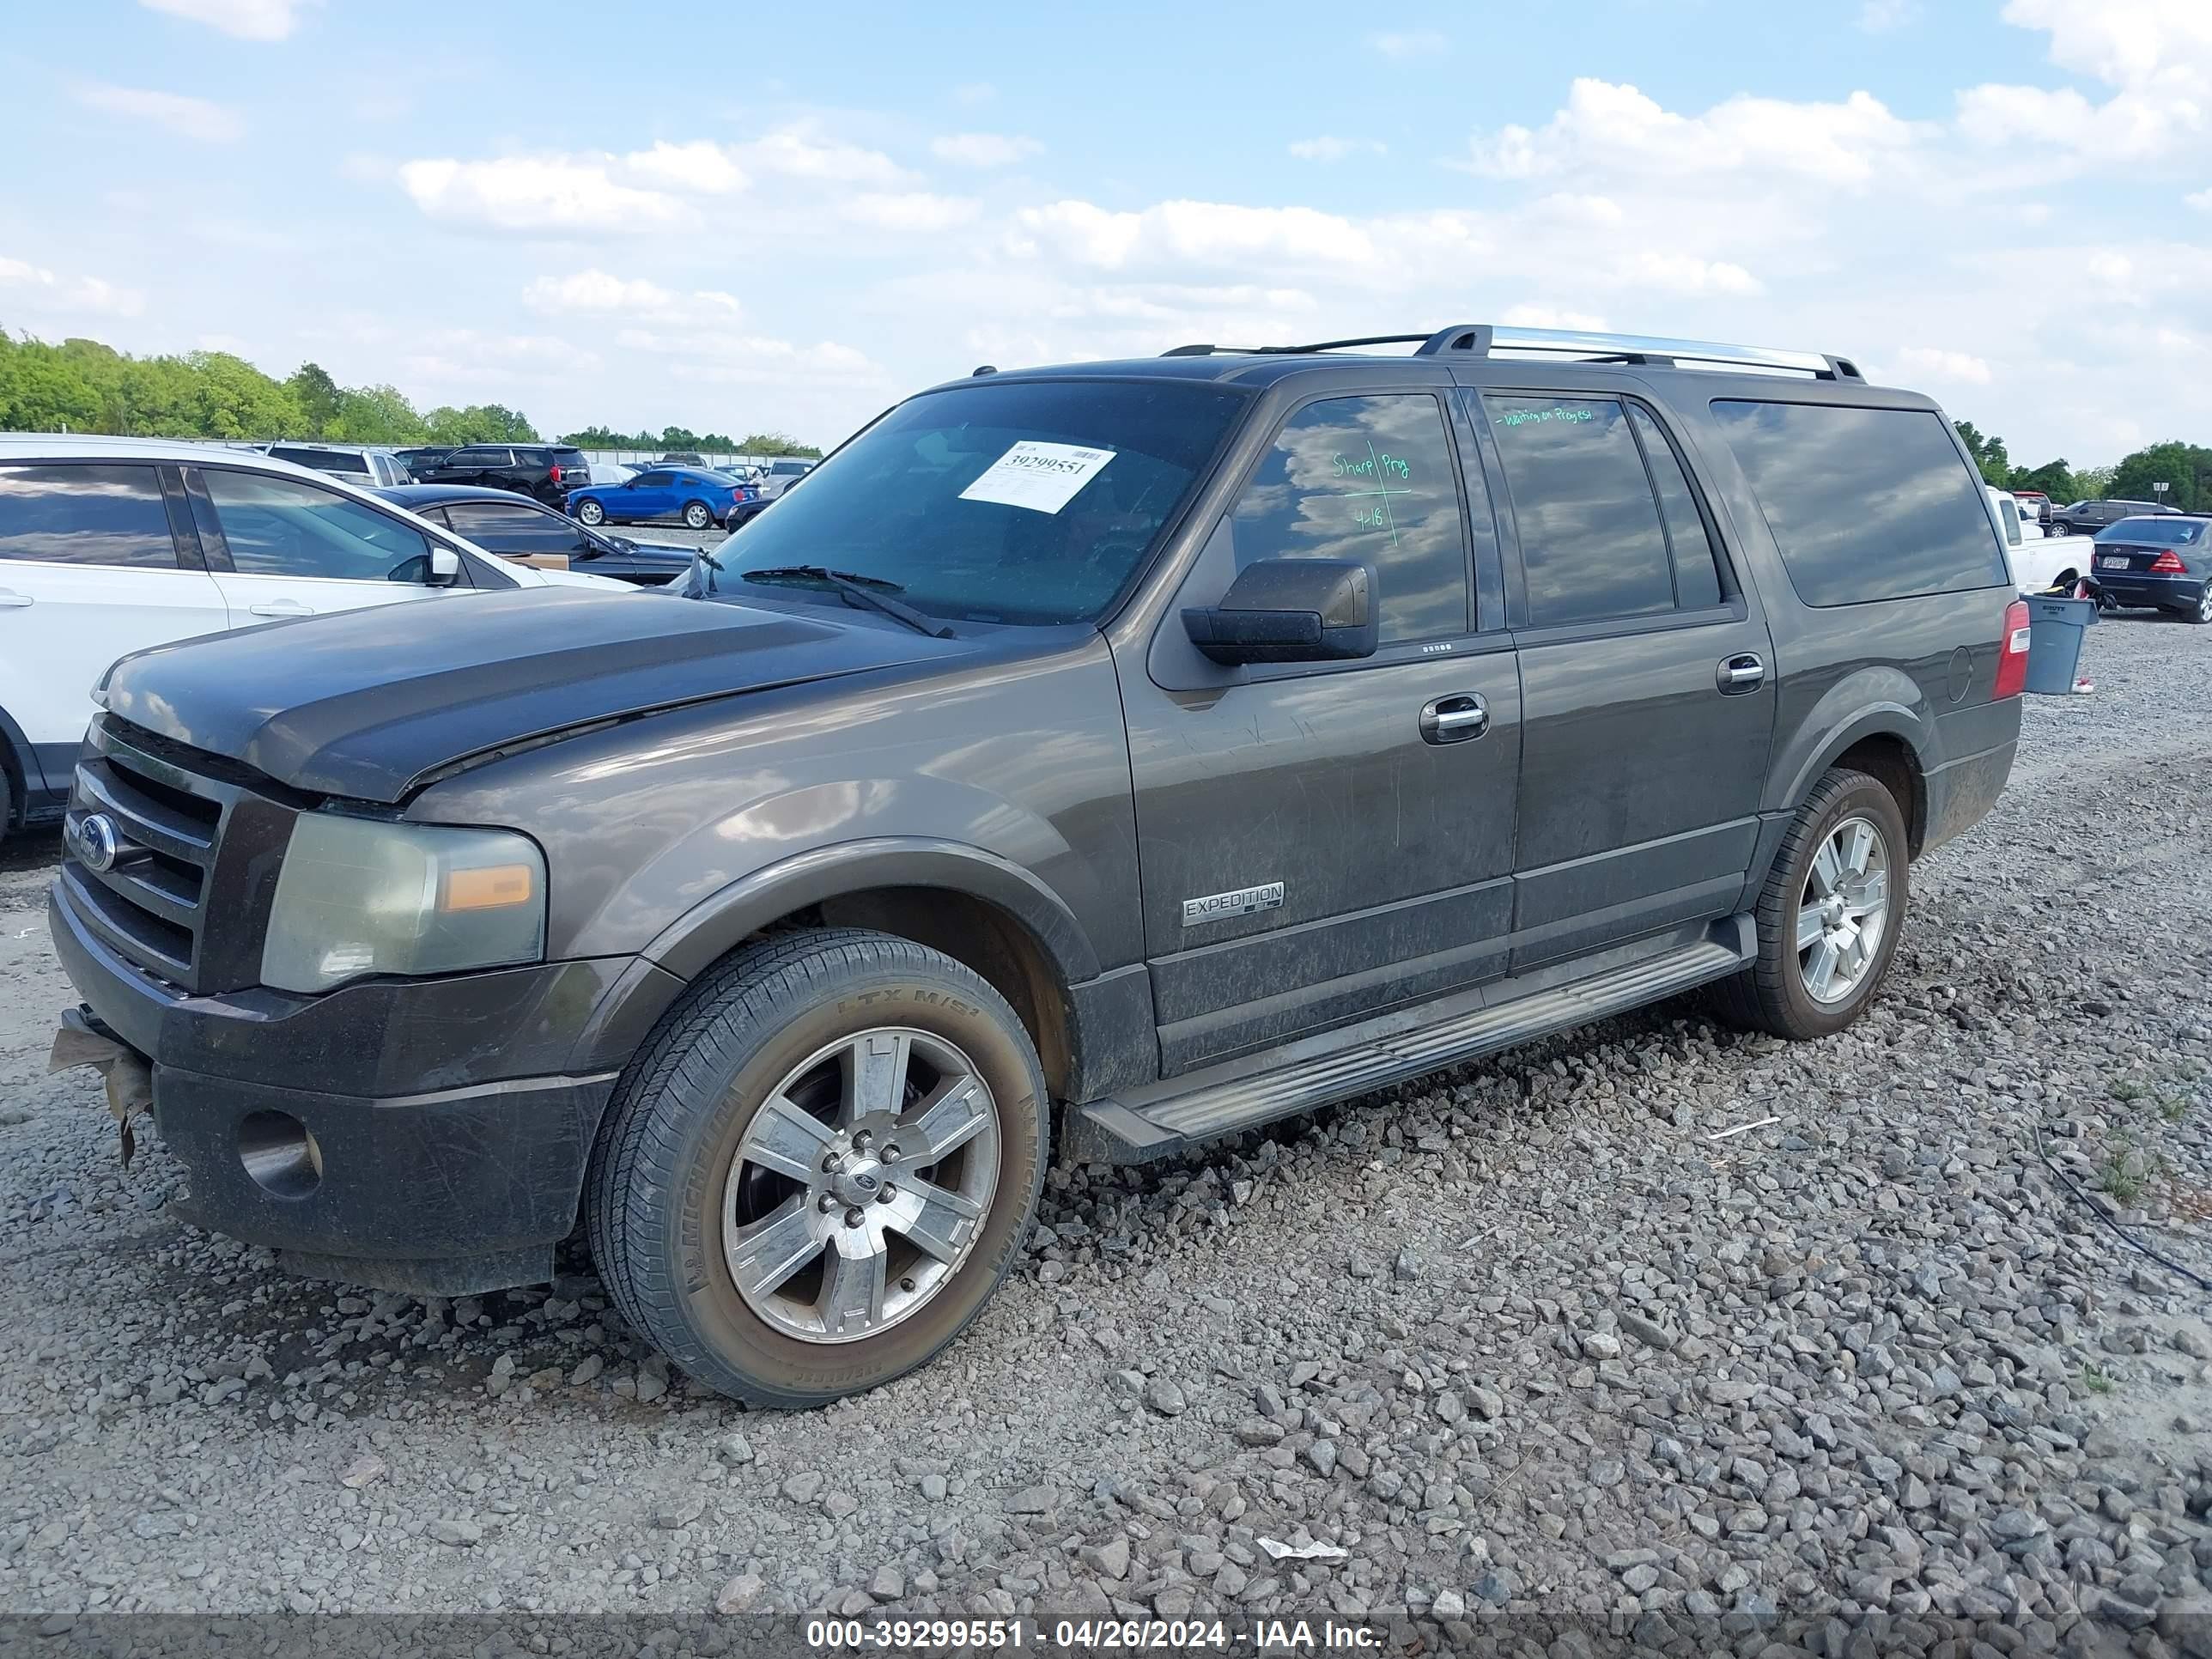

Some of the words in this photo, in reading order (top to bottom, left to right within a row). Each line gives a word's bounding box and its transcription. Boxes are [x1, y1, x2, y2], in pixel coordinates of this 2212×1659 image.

[1005, 455, 1086, 475] 39299551
[1333, 453, 1373, 477] Sharp
[1187, 885, 1283, 916] EXPEDITION
[836, 988, 902, 1015] LTX
